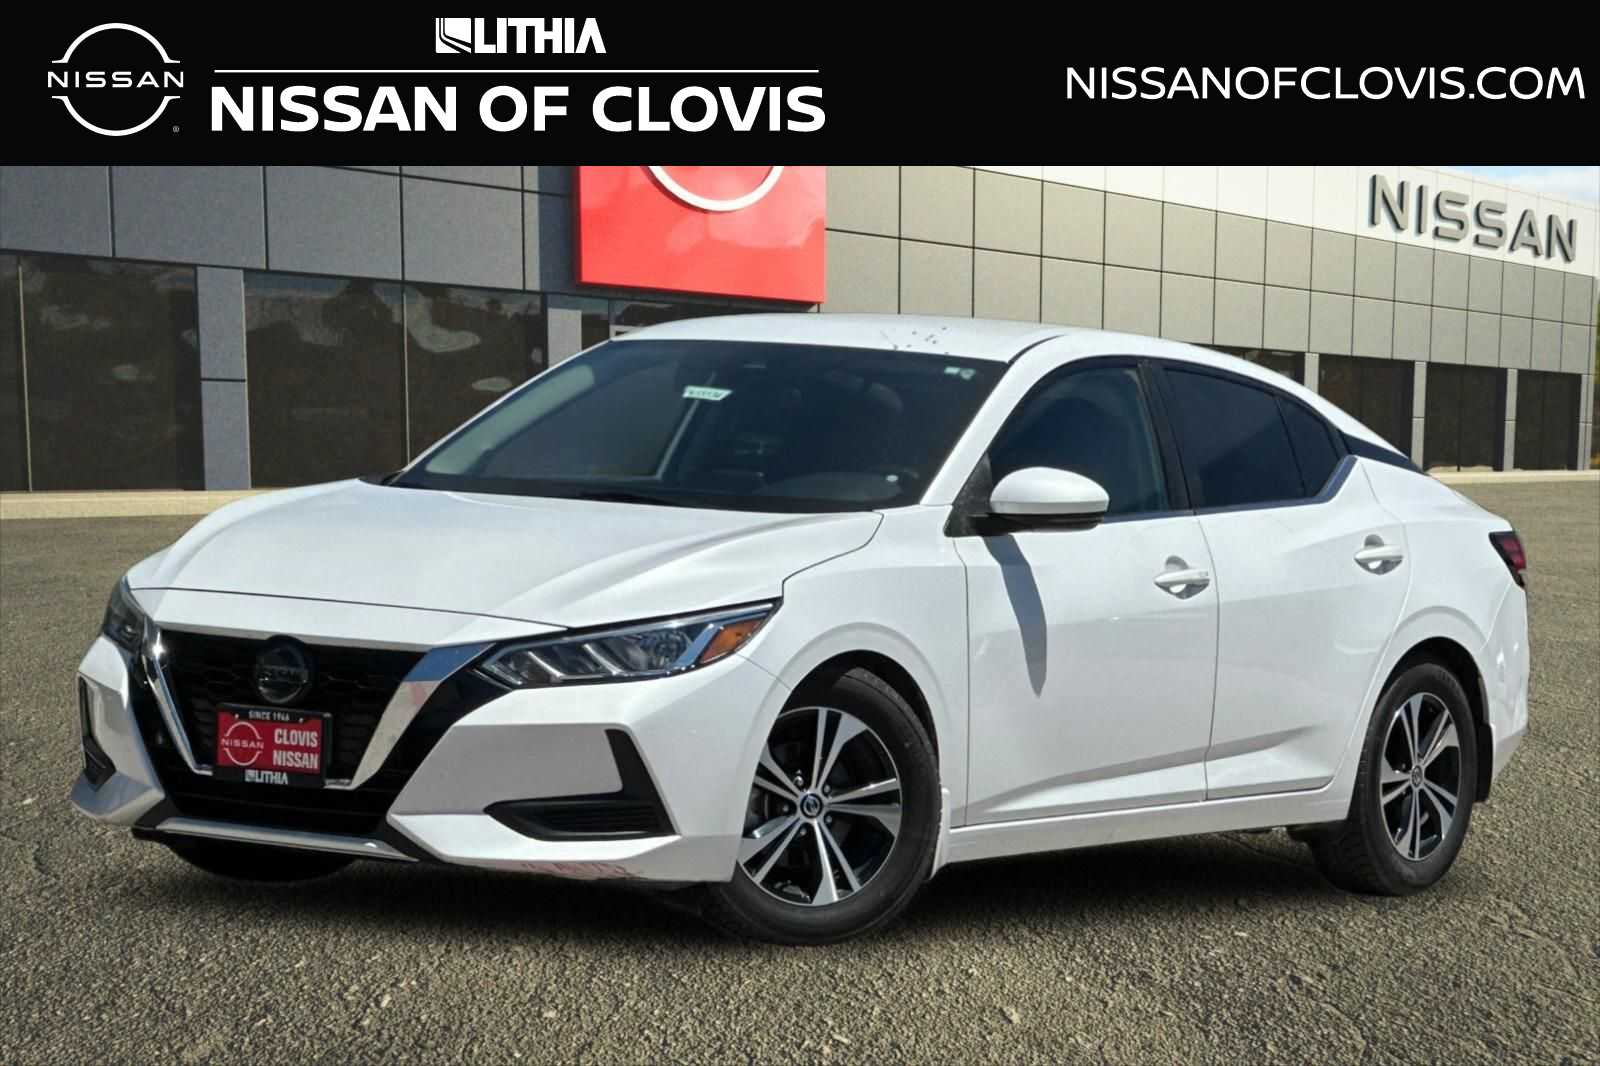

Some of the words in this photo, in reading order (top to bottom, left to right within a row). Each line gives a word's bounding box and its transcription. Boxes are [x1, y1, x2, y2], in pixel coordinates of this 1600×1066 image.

[1368, 173, 1577, 263] NISSAN
[248, 710, 271, 720] SINCE
[221, 738, 264, 750] NISSAN
[274, 728, 318, 748] CLOVIS
[272, 749, 319, 769] NISSAN
[255, 769, 289, 785] LITHIA
